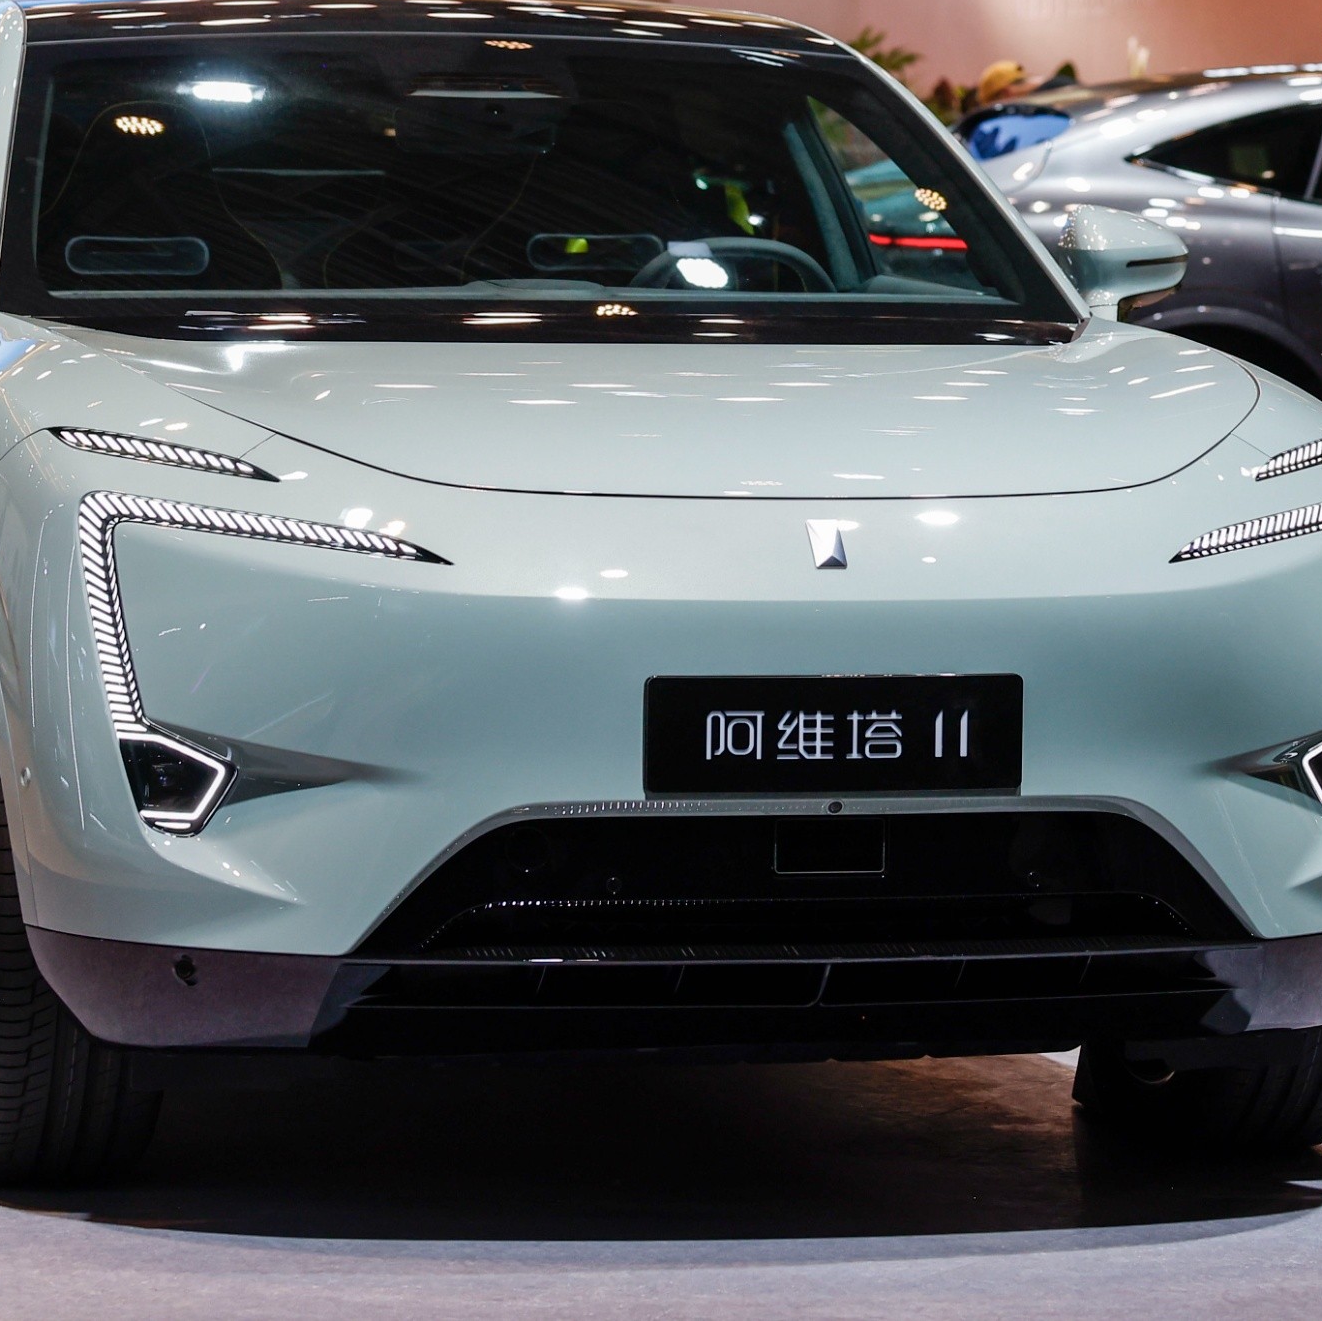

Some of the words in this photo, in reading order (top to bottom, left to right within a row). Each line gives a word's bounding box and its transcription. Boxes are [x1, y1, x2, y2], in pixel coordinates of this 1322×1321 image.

[706, 709, 902, 760] 阿维塔
[934, 709, 969, 758] 11
